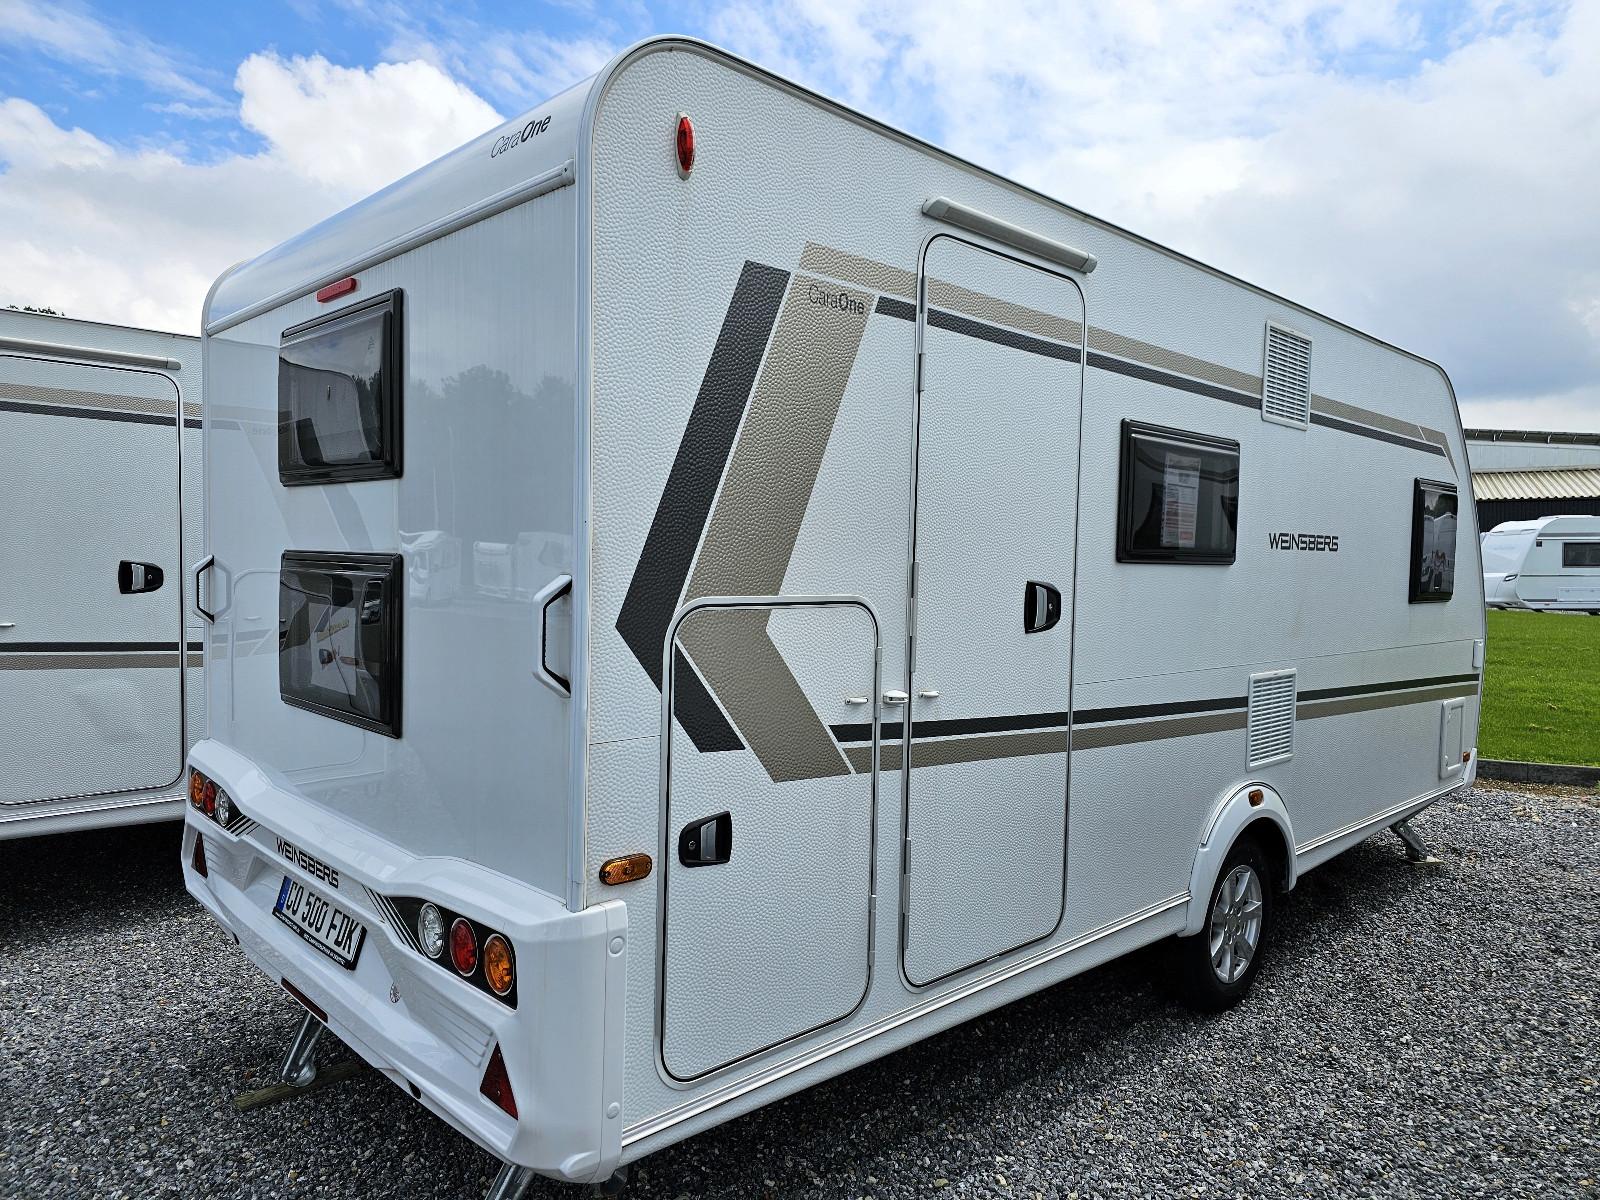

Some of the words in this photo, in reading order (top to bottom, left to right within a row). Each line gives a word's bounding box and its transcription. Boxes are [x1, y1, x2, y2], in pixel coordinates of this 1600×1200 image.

[490, 115, 552, 159] CaraOne
[808, 283, 865, 315] CaraOne
[1268, 532, 1339, 552] WEINSBERG
[276, 837, 339, 889] WEINSBERG
[301, 892, 330, 933] 500
[326, 908, 360, 954] FDK
